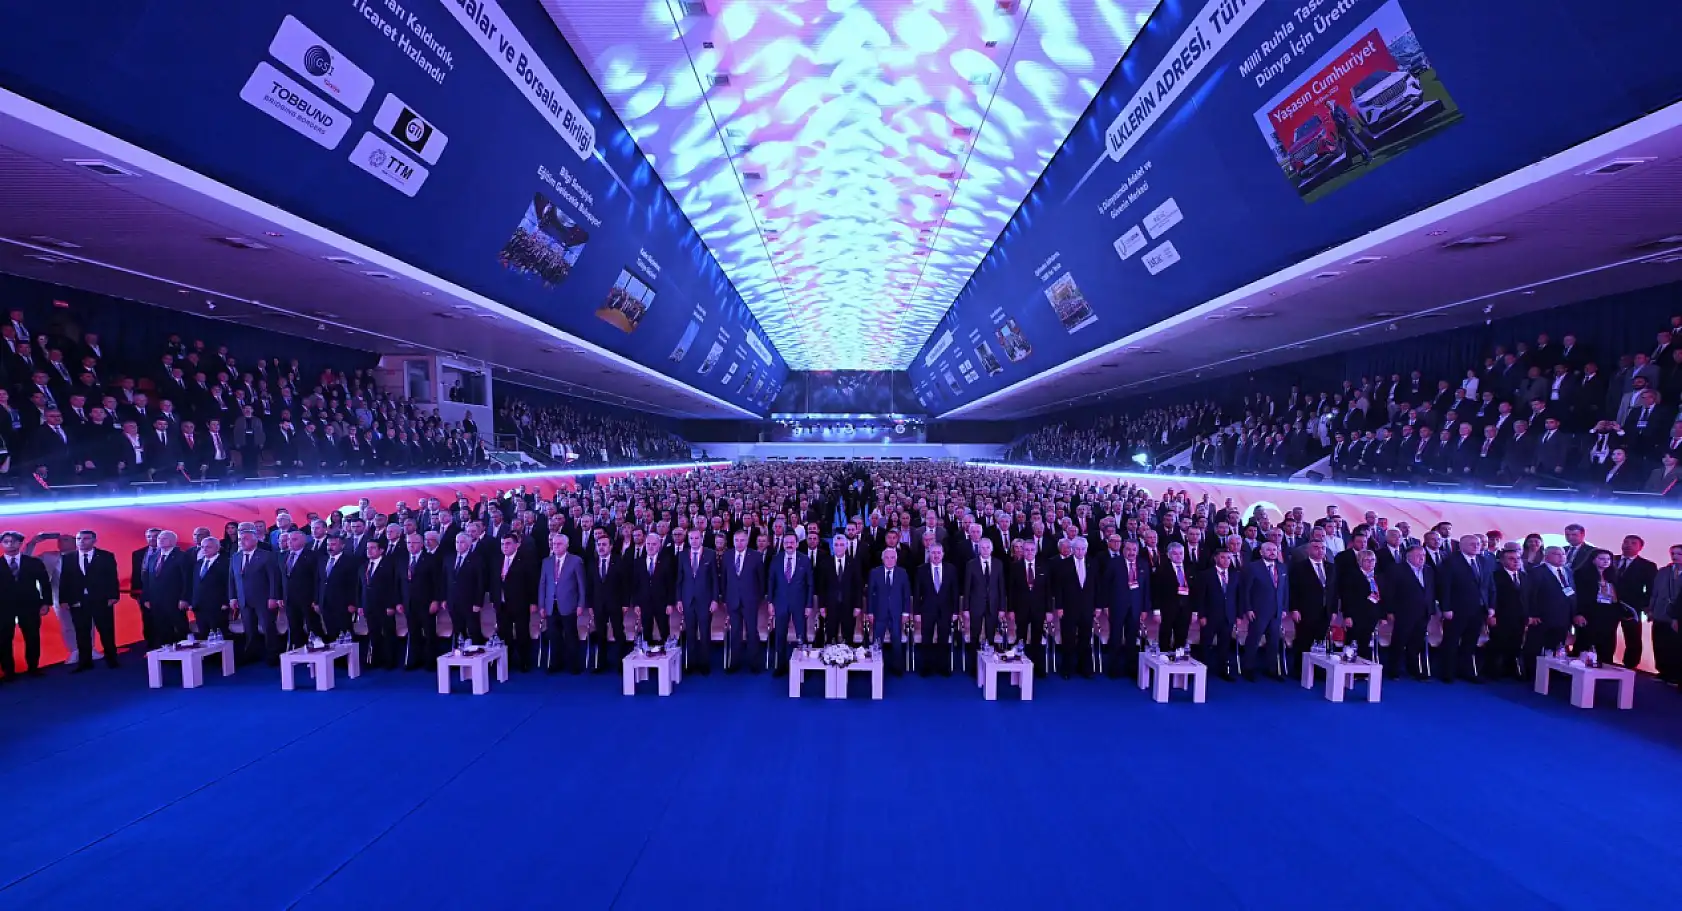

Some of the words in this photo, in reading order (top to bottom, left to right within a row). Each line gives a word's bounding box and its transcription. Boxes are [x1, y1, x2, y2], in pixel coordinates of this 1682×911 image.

[316, 58, 335, 76] GS1
[397, 34, 446, 84] Hızlandı!
[406, 12, 454, 70] Kaldırdık,
[1239, 50, 1261, 78] Milli
[1261, 21, 1295, 57] Ruhla
[1255, 52, 1291, 88] Dünya
[1289, 31, 1314, 57] İçin
[271, 81, 334, 127] TOBBUND
[499, 33, 515, 63] ve
[516, 52, 563, 119] Borsalar
[562, 109, 592, 152] Birliği
[1109, 90, 1156, 152] İLKLERİN
[1155, 26, 1211, 102] ADRESİ,
[1273, 91, 1313, 123] Yaşasın
[1312, 40, 1377, 95] Cumhuriyet
[263, 95, 296, 118] BRIDGING
[296, 114, 326, 135] BORDERS
[387, 155, 414, 180] TTM
